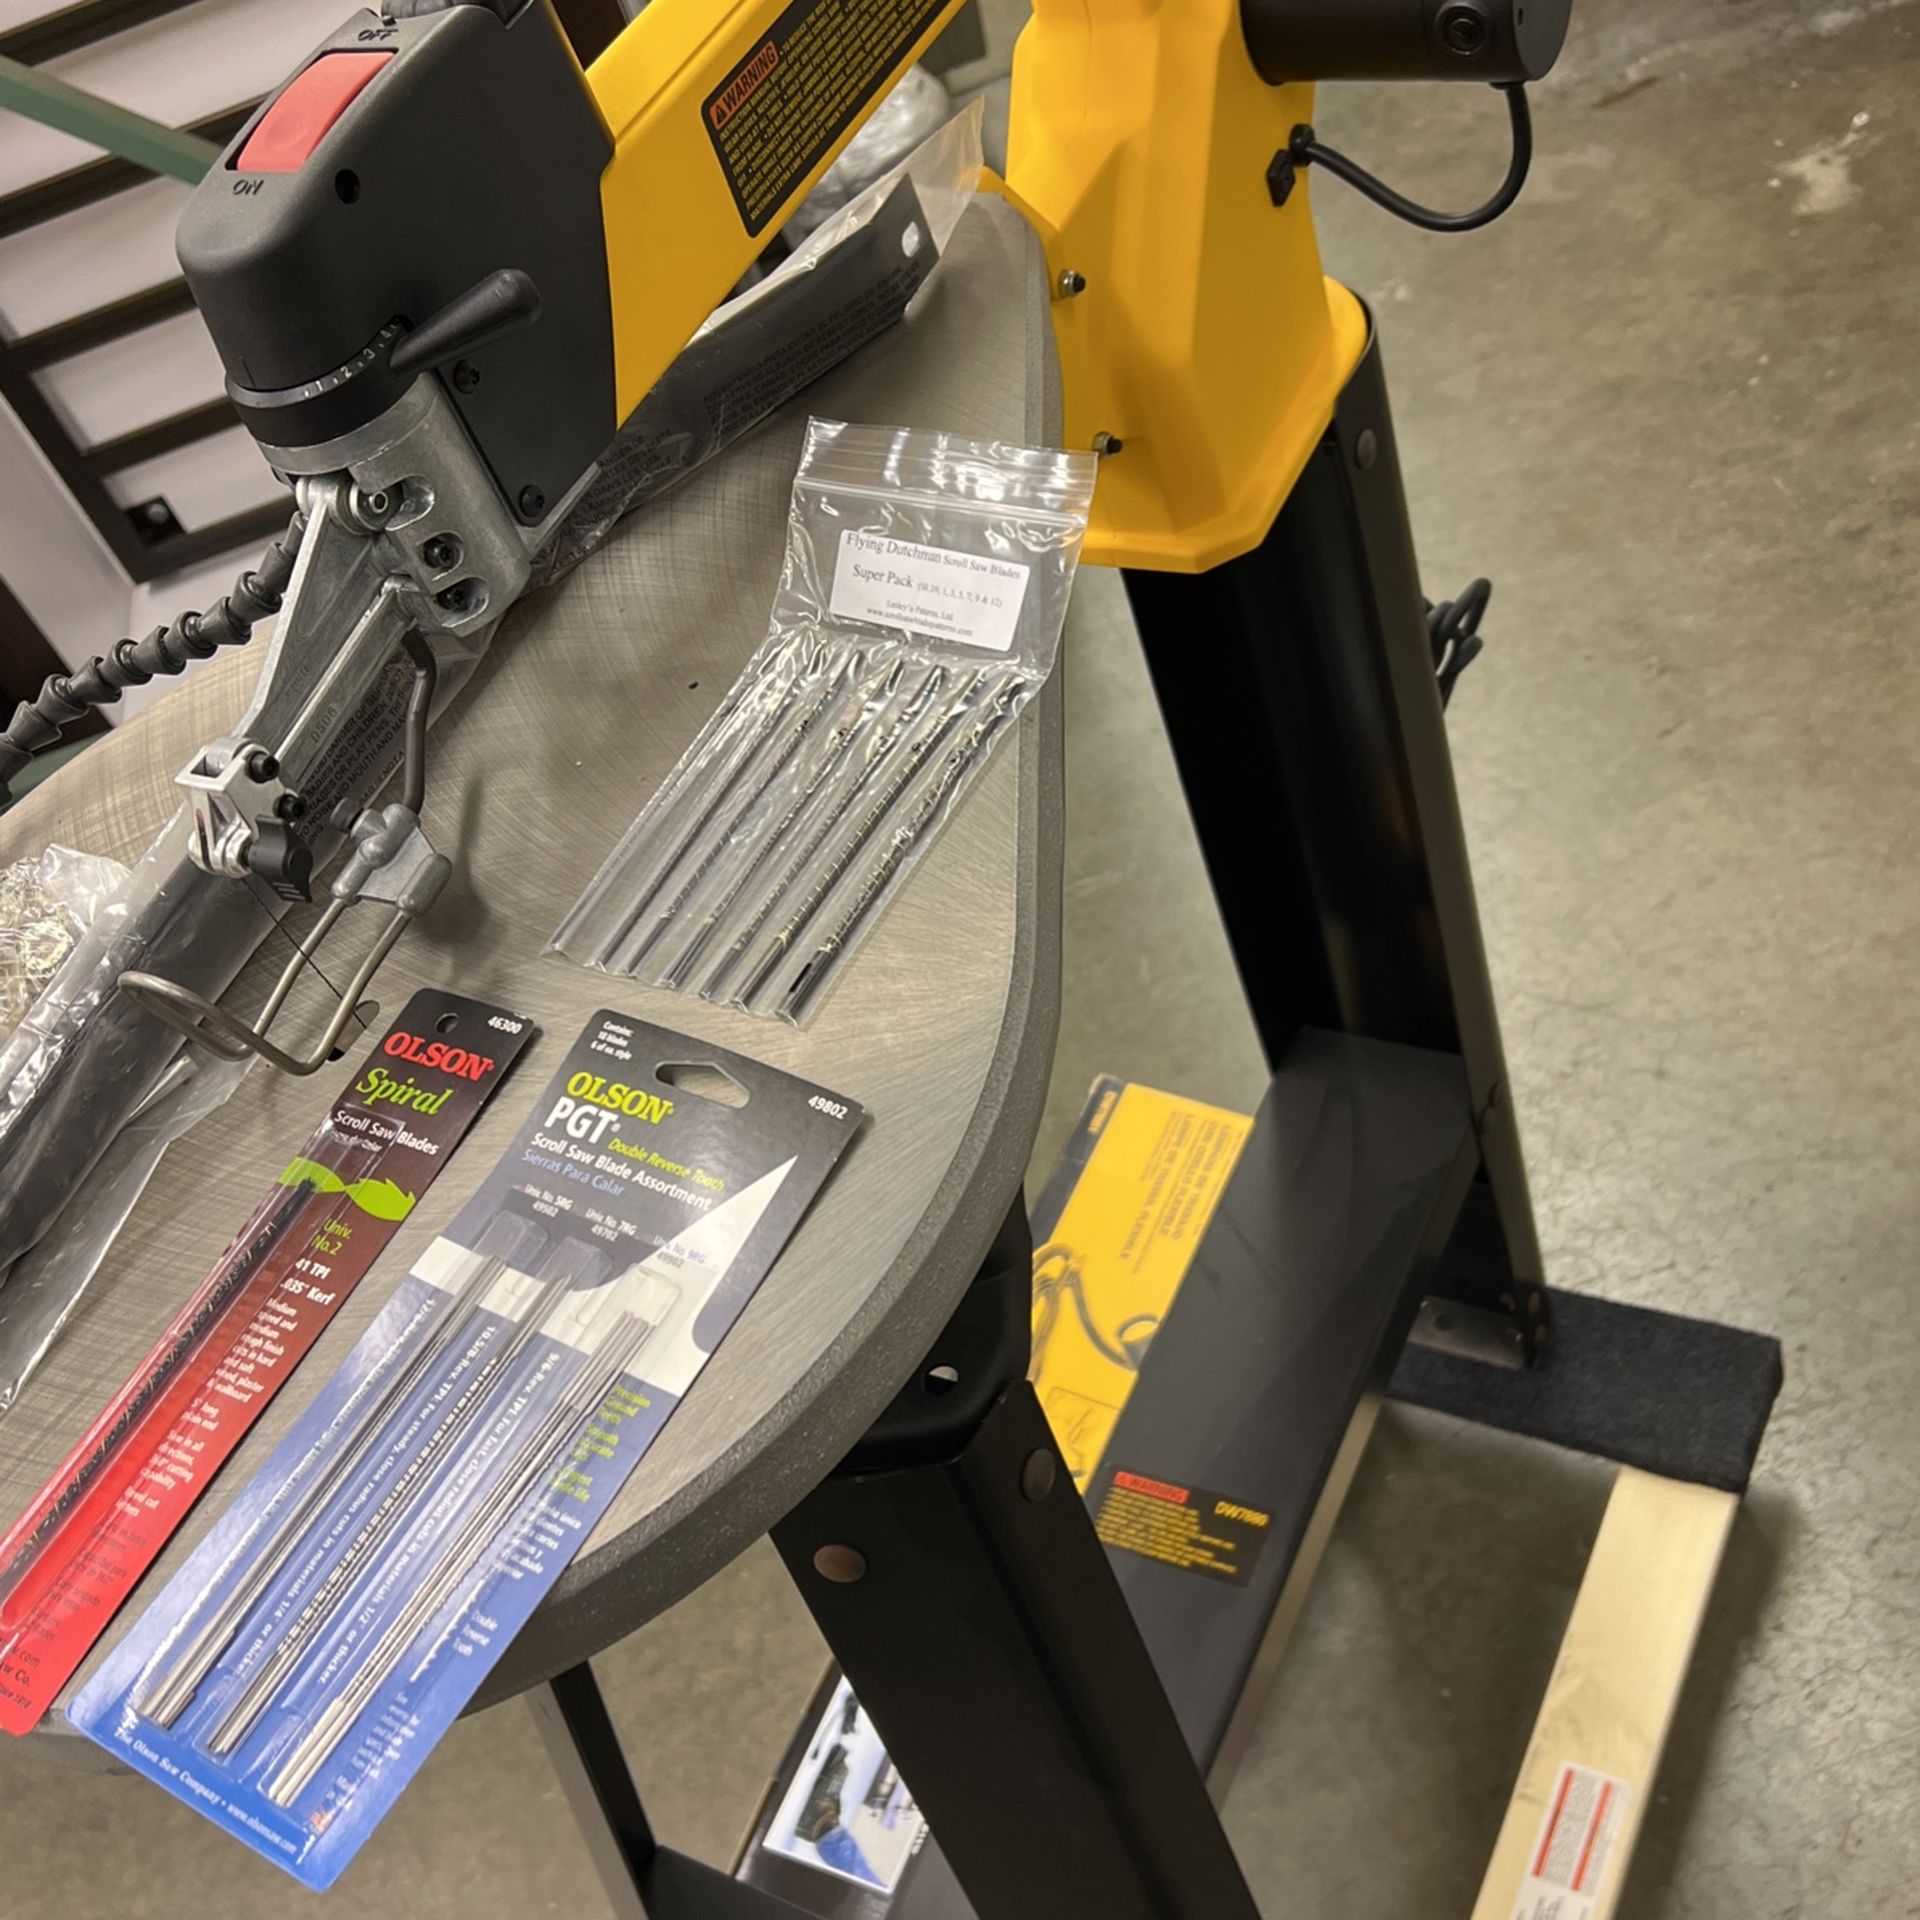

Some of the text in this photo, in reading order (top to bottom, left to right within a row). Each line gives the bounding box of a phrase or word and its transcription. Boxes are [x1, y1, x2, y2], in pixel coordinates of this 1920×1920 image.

[722, 44, 776, 114] WARNING
[232, 179, 264, 195] ON
[340, 366, 354, 379] 2
[363, 347, 376, 361] 3
[845, 532, 1021, 580] Flying Dutchman Scroll Saw Blades
[851, 563, 885, 585] Super
[886, 570, 914, 588] Pack
[322, 702, 369, 758] DANGER OF
[328, 743, 350, 768] AND
[332, 762, 350, 782] OR
[345, 740, 369, 768] PLAY
[346, 747, 378, 785] MOUTH
[374, 728, 395, 753] AND
[486, 1015, 523, 1035] 46300
[383, 1030, 494, 1082] OLSON
[355, 1067, 454, 1115] Spiral
[566, 1071, 669, 1125] OLSON
[807, 1094, 848, 1120] 49802
[334, 1110, 367, 1131] Scroll
[369, 1121, 395, 1140] Saw
[397, 1131, 439, 1156] Blades
[544, 1096, 618, 1144] PGT
[522, 1150, 625, 1197] Sierras Para Calar
[531, 1132, 713, 1211] Scroll Saw Blade Assortment
[607, 1138, 726, 1192] Double Reverse Tooth
[322, 1217, 356, 1240] Univ.
[293, 1256, 332, 1279] 41 TPI
[264, 1296, 300, 1317] Medium
[305, 1284, 337, 1306] Kerf
[278, 1316, 299, 1332] and
[254, 1351, 278, 1368] hard
[260, 1338, 287, 1356] finish
[520, 1348, 560, 1398] 9/6-Rev.
[416, 1400, 436, 1422] For
[491, 1415, 511, 1436] For
[387, 1416, 423, 1458] steady,
[472, 1431, 499, 1461] fast,
[370, 1453, 397, 1485] close
[454, 1456, 481, 1487] close
[345, 1479, 377, 1516] radius
[430, 1482, 461, 1520] radius
[329, 1511, 353, 1539] cuts
[414, 1516, 437, 1542] cuts
[284, 1546, 327, 1600] materials
[369, 1551, 412, 1607] materials
[458, 1623, 494, 1648] Reverse
[467, 1609, 502, 1633] Double
[449, 1637, 477, 1657] Tooth
[314, 1641, 350, 1686] thicker.
[112, 1725, 134, 1745] The
[131, 1738, 161, 1763] Olson
[157, 1755, 183, 1777] Saw
[176, 1769, 223, 1807] Company
